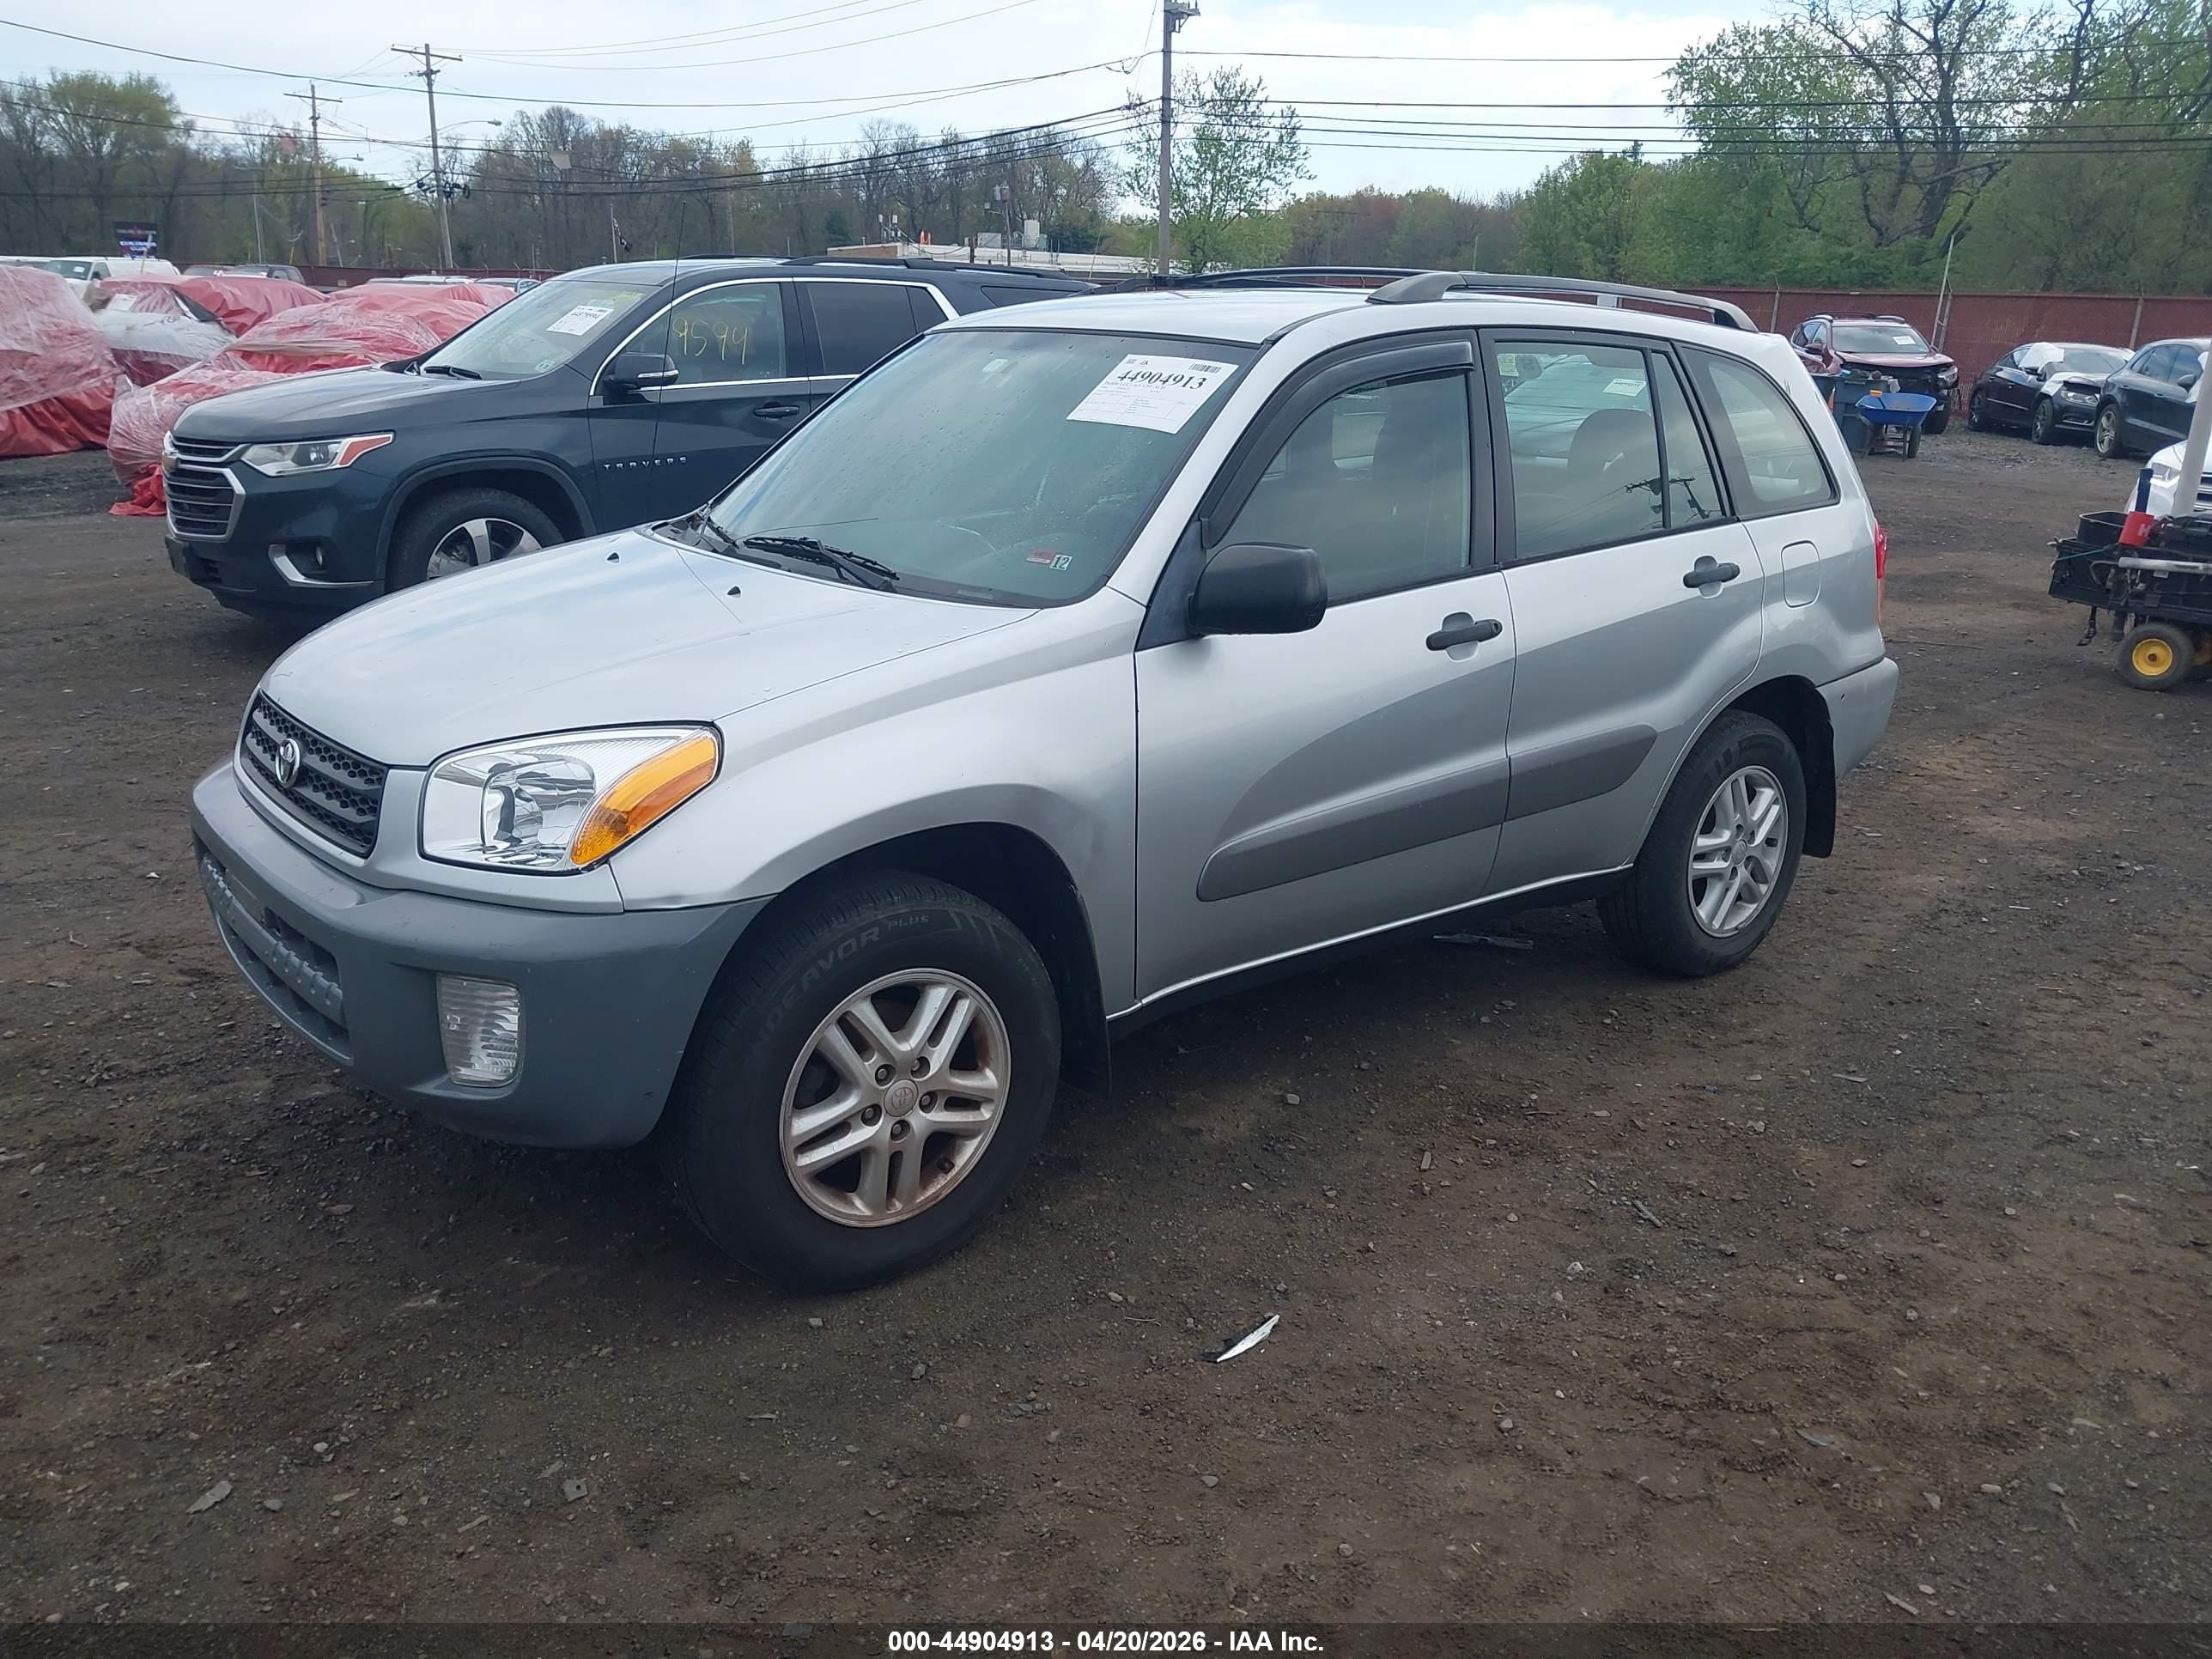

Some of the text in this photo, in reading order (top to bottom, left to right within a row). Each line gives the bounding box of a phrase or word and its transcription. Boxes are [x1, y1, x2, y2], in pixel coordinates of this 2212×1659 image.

[672, 317, 748, 365] 9594
[1117, 369, 1207, 390] 44904913
[1051, 556, 1070, 569] 12
[886, 914, 930, 930] PLUS
